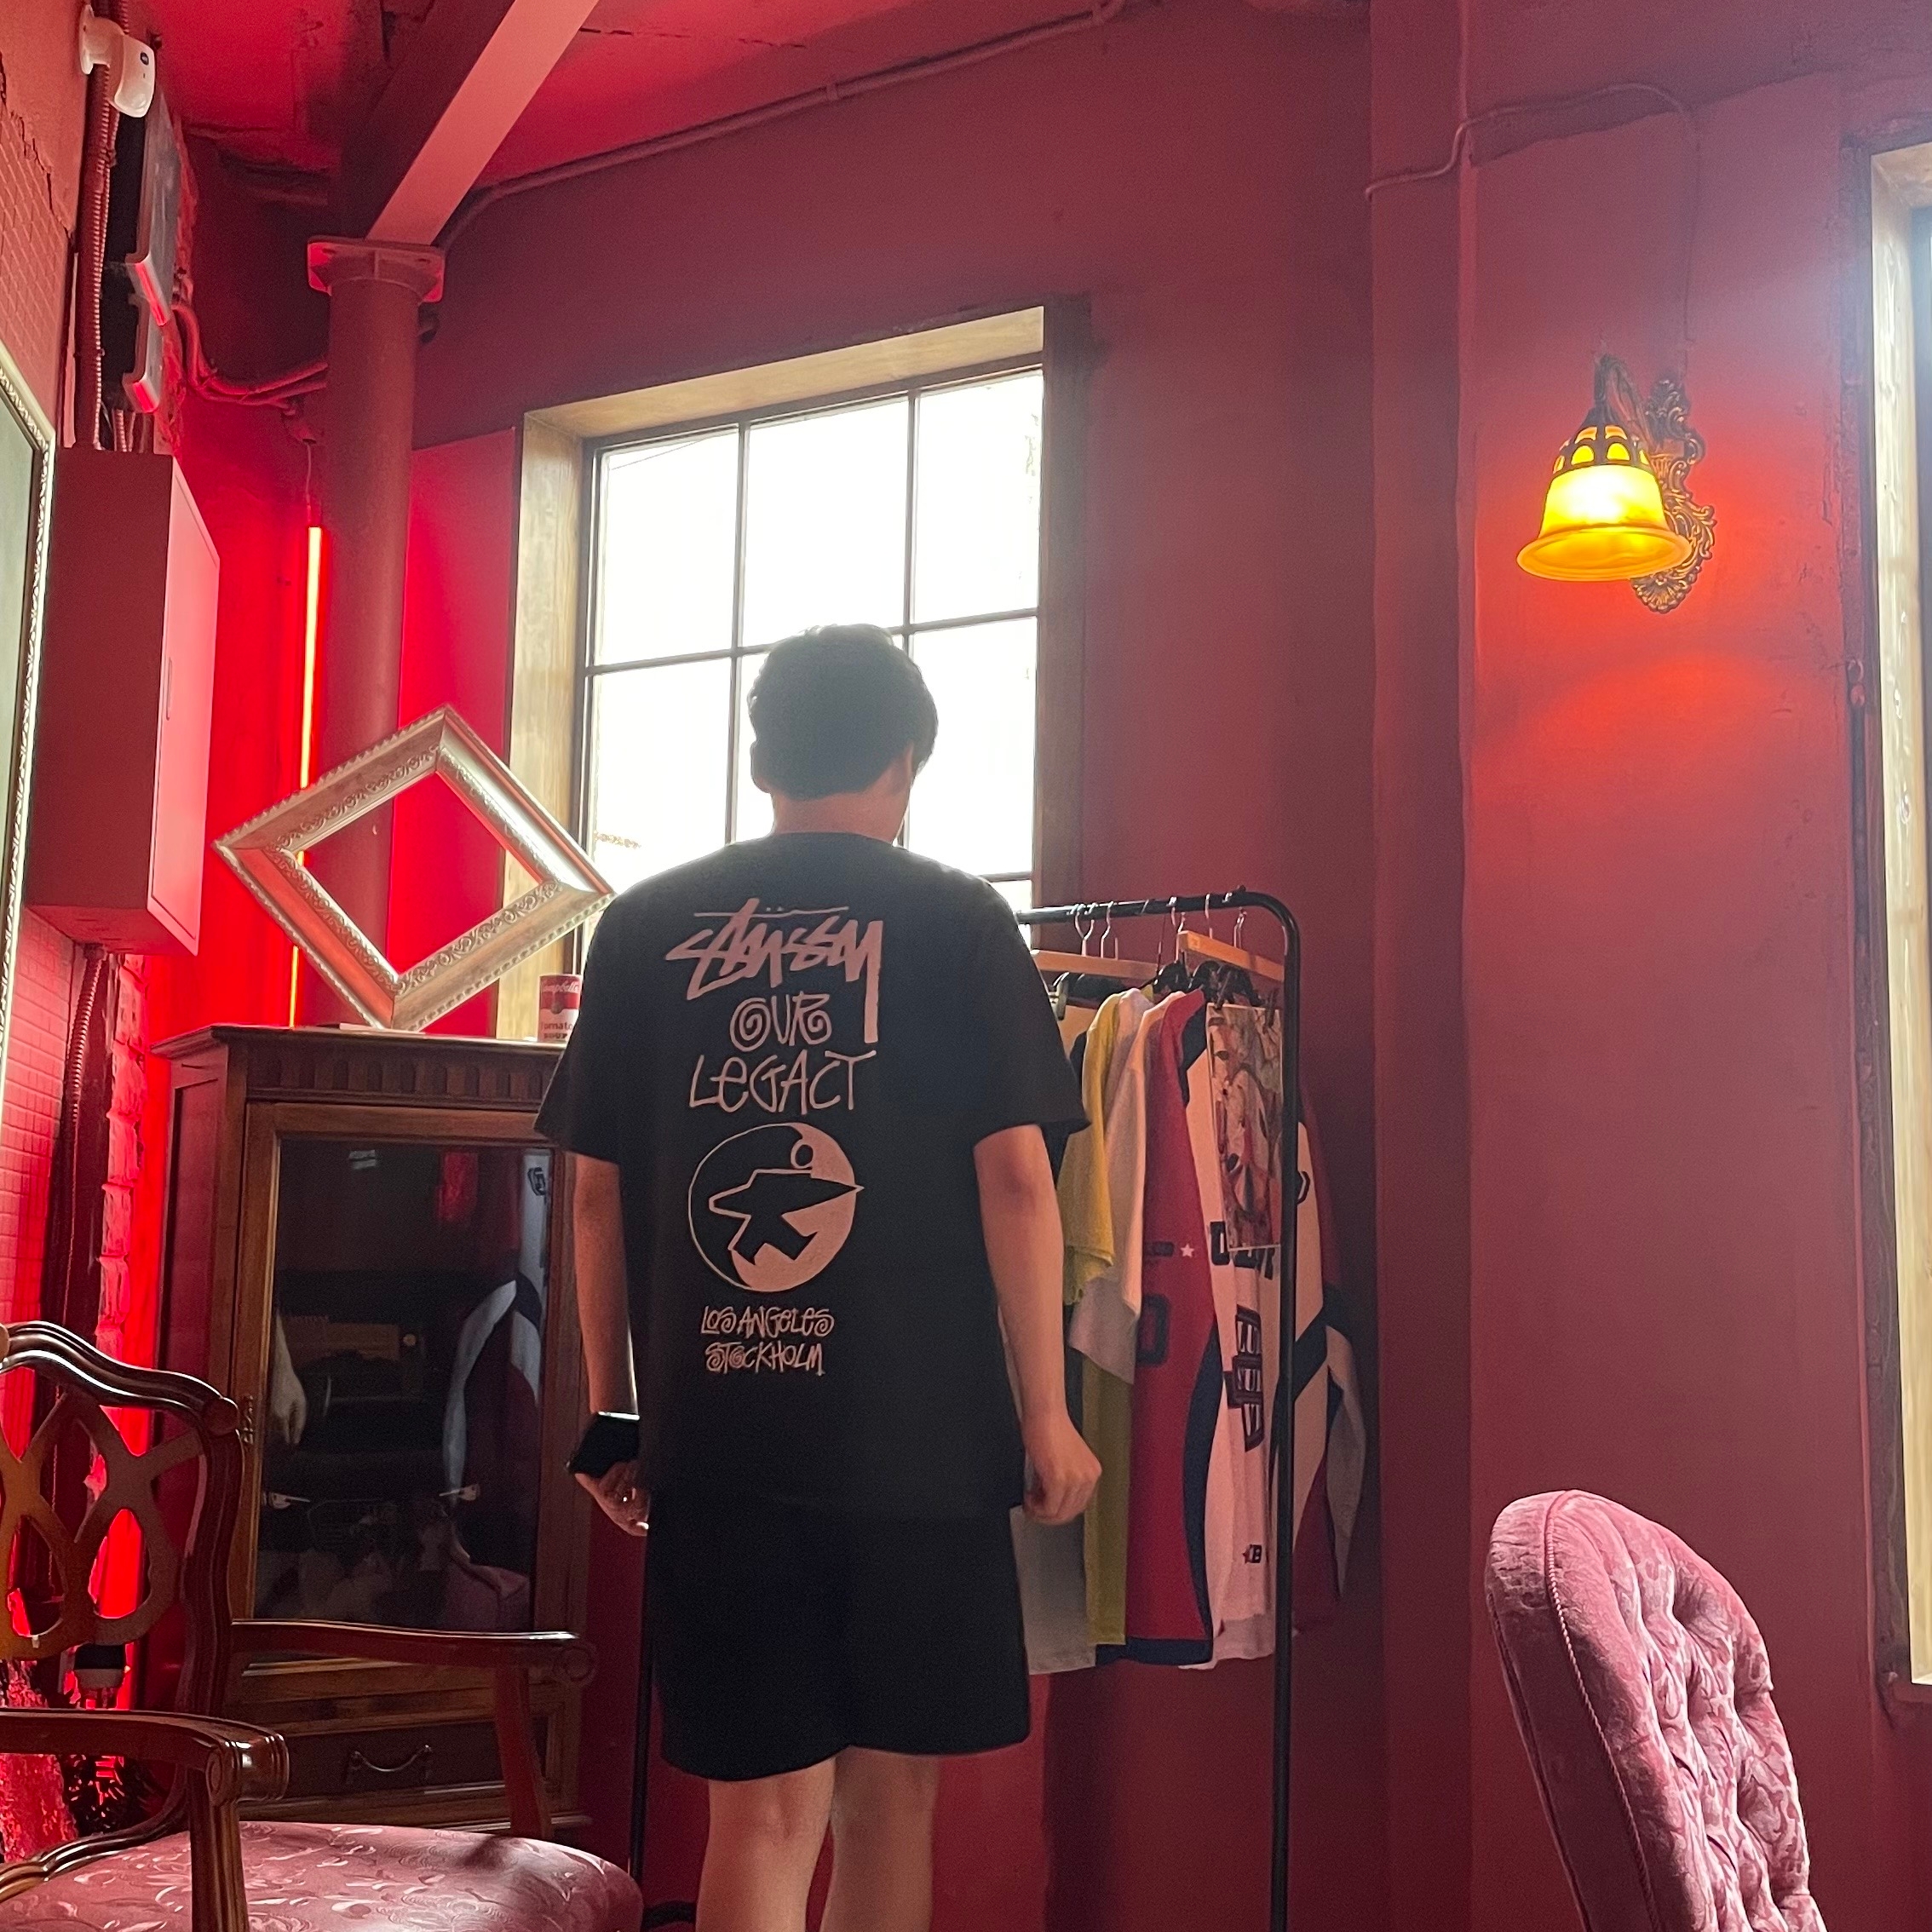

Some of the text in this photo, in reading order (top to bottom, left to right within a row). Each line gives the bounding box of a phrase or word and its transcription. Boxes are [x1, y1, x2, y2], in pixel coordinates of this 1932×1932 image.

[729, 991, 832, 1052] OUR
[700, 1306, 736, 1335] LOS
[704, 1340, 825, 1376] STOCKHOLM
